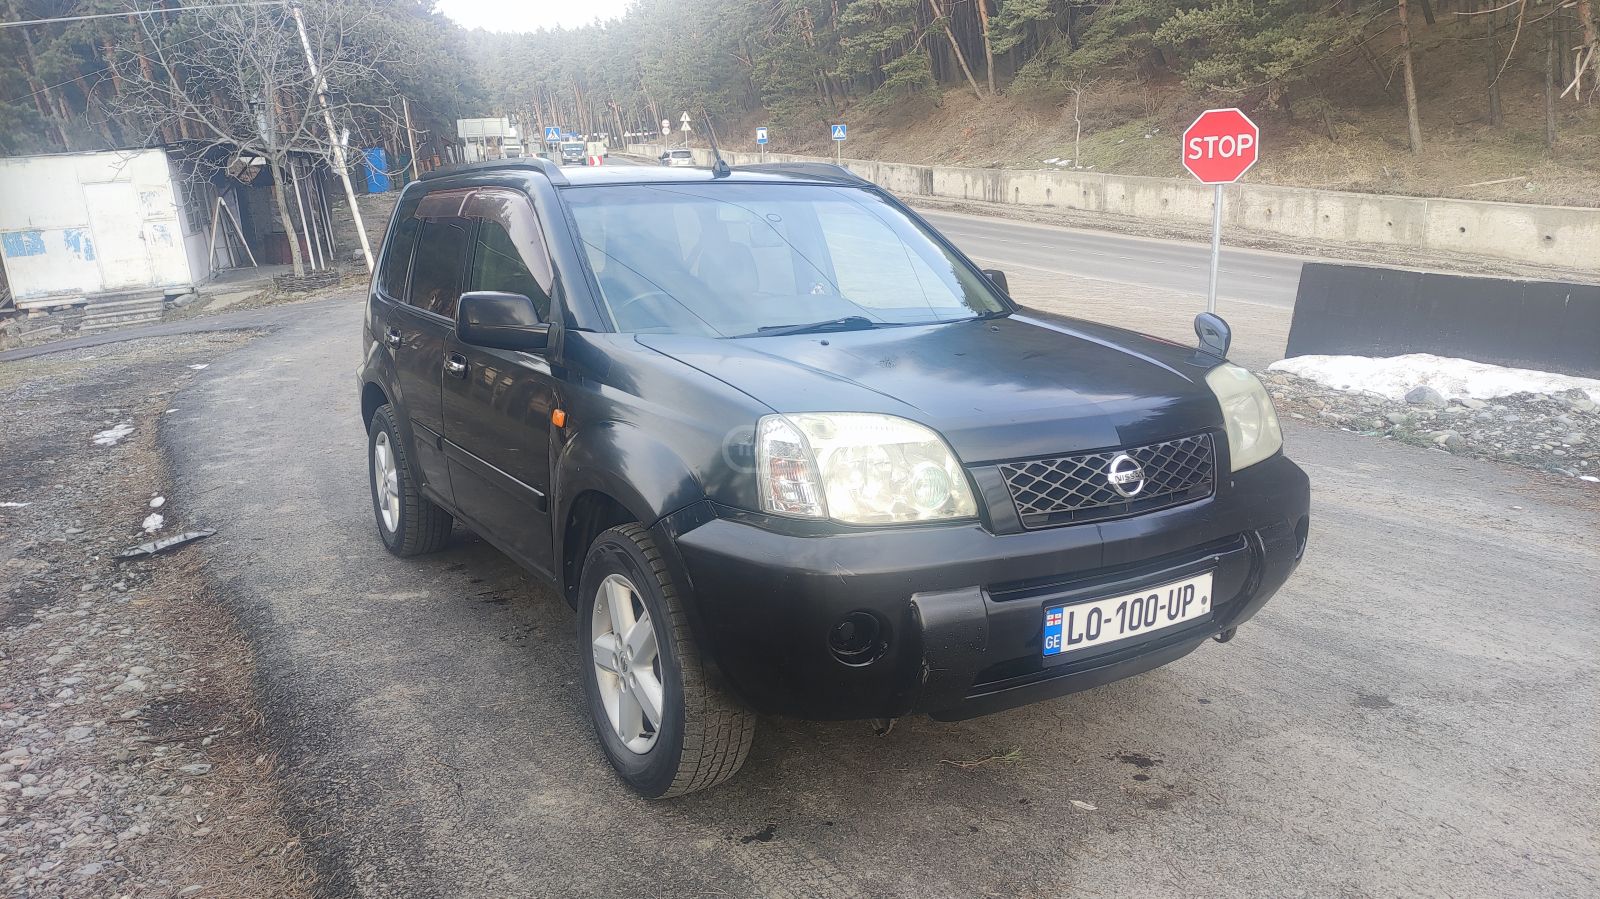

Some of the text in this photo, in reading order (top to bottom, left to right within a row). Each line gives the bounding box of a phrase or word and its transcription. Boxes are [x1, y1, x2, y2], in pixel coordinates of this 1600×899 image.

[1188, 134, 1254, 160] STOP
[1114, 471, 1144, 482] NISSAN
[1067, 583, 1195, 646] LO-100-UP
[1045, 634, 1060, 650] GE
